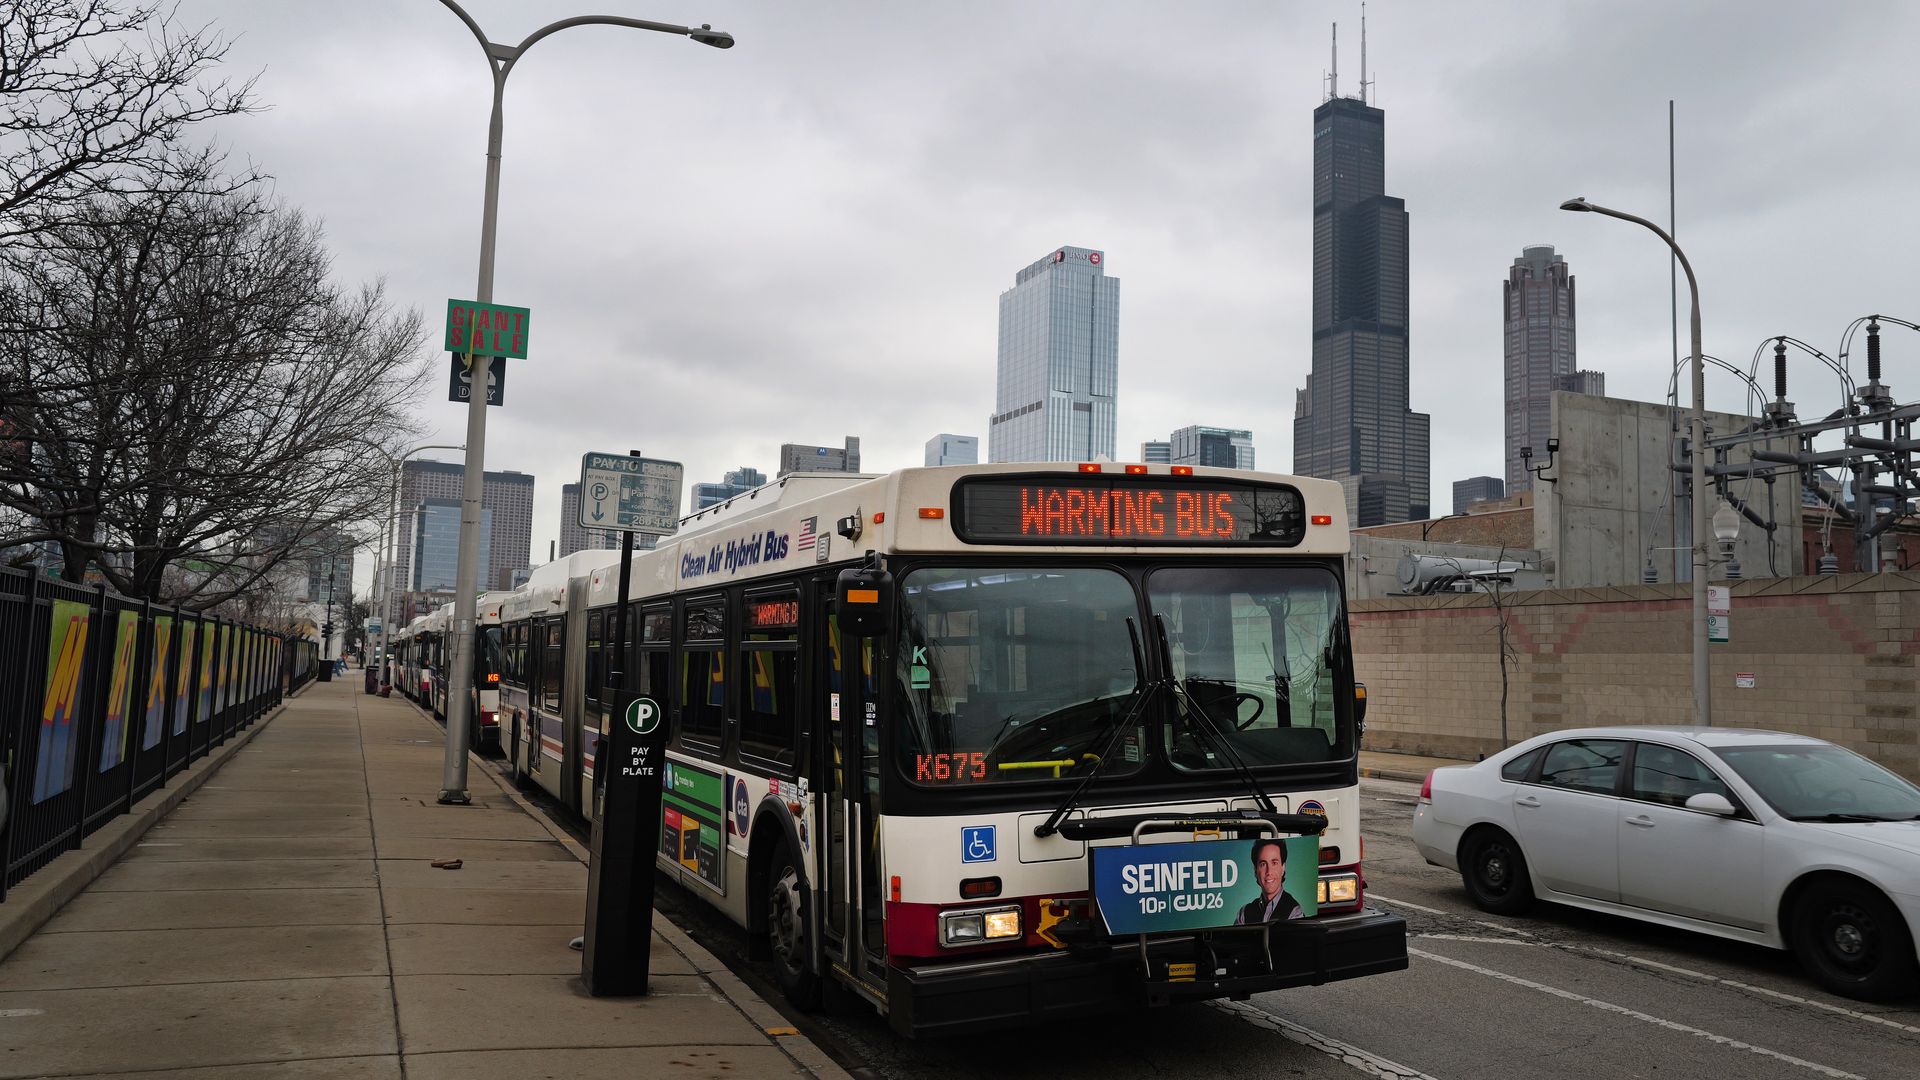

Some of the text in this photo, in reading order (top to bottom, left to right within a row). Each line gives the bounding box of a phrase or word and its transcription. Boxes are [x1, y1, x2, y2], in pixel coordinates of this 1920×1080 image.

[452, 306, 524, 332] GIANT
[450, 327, 524, 353] SALE
[458, 385, 496, 401] DY
[592, 457, 617, 469] PAY
[620, 460, 639, 472] TO
[1022, 488, 1234, 538] WARMING BUS
[681, 531, 790, 579] Clean Air Hybrid Bus
[757, 603, 790, 625] WARMING
[912, 646, 928, 665] K
[637, 704, 653, 728] P
[631, 747, 649, 756] PAY
[632, 757, 646, 766] BY
[622, 767, 654, 776] PLATE
[917, 752, 986, 780] K675
[737, 798, 748, 817] cta
[1121, 859, 1238, 894] SEINFELD
